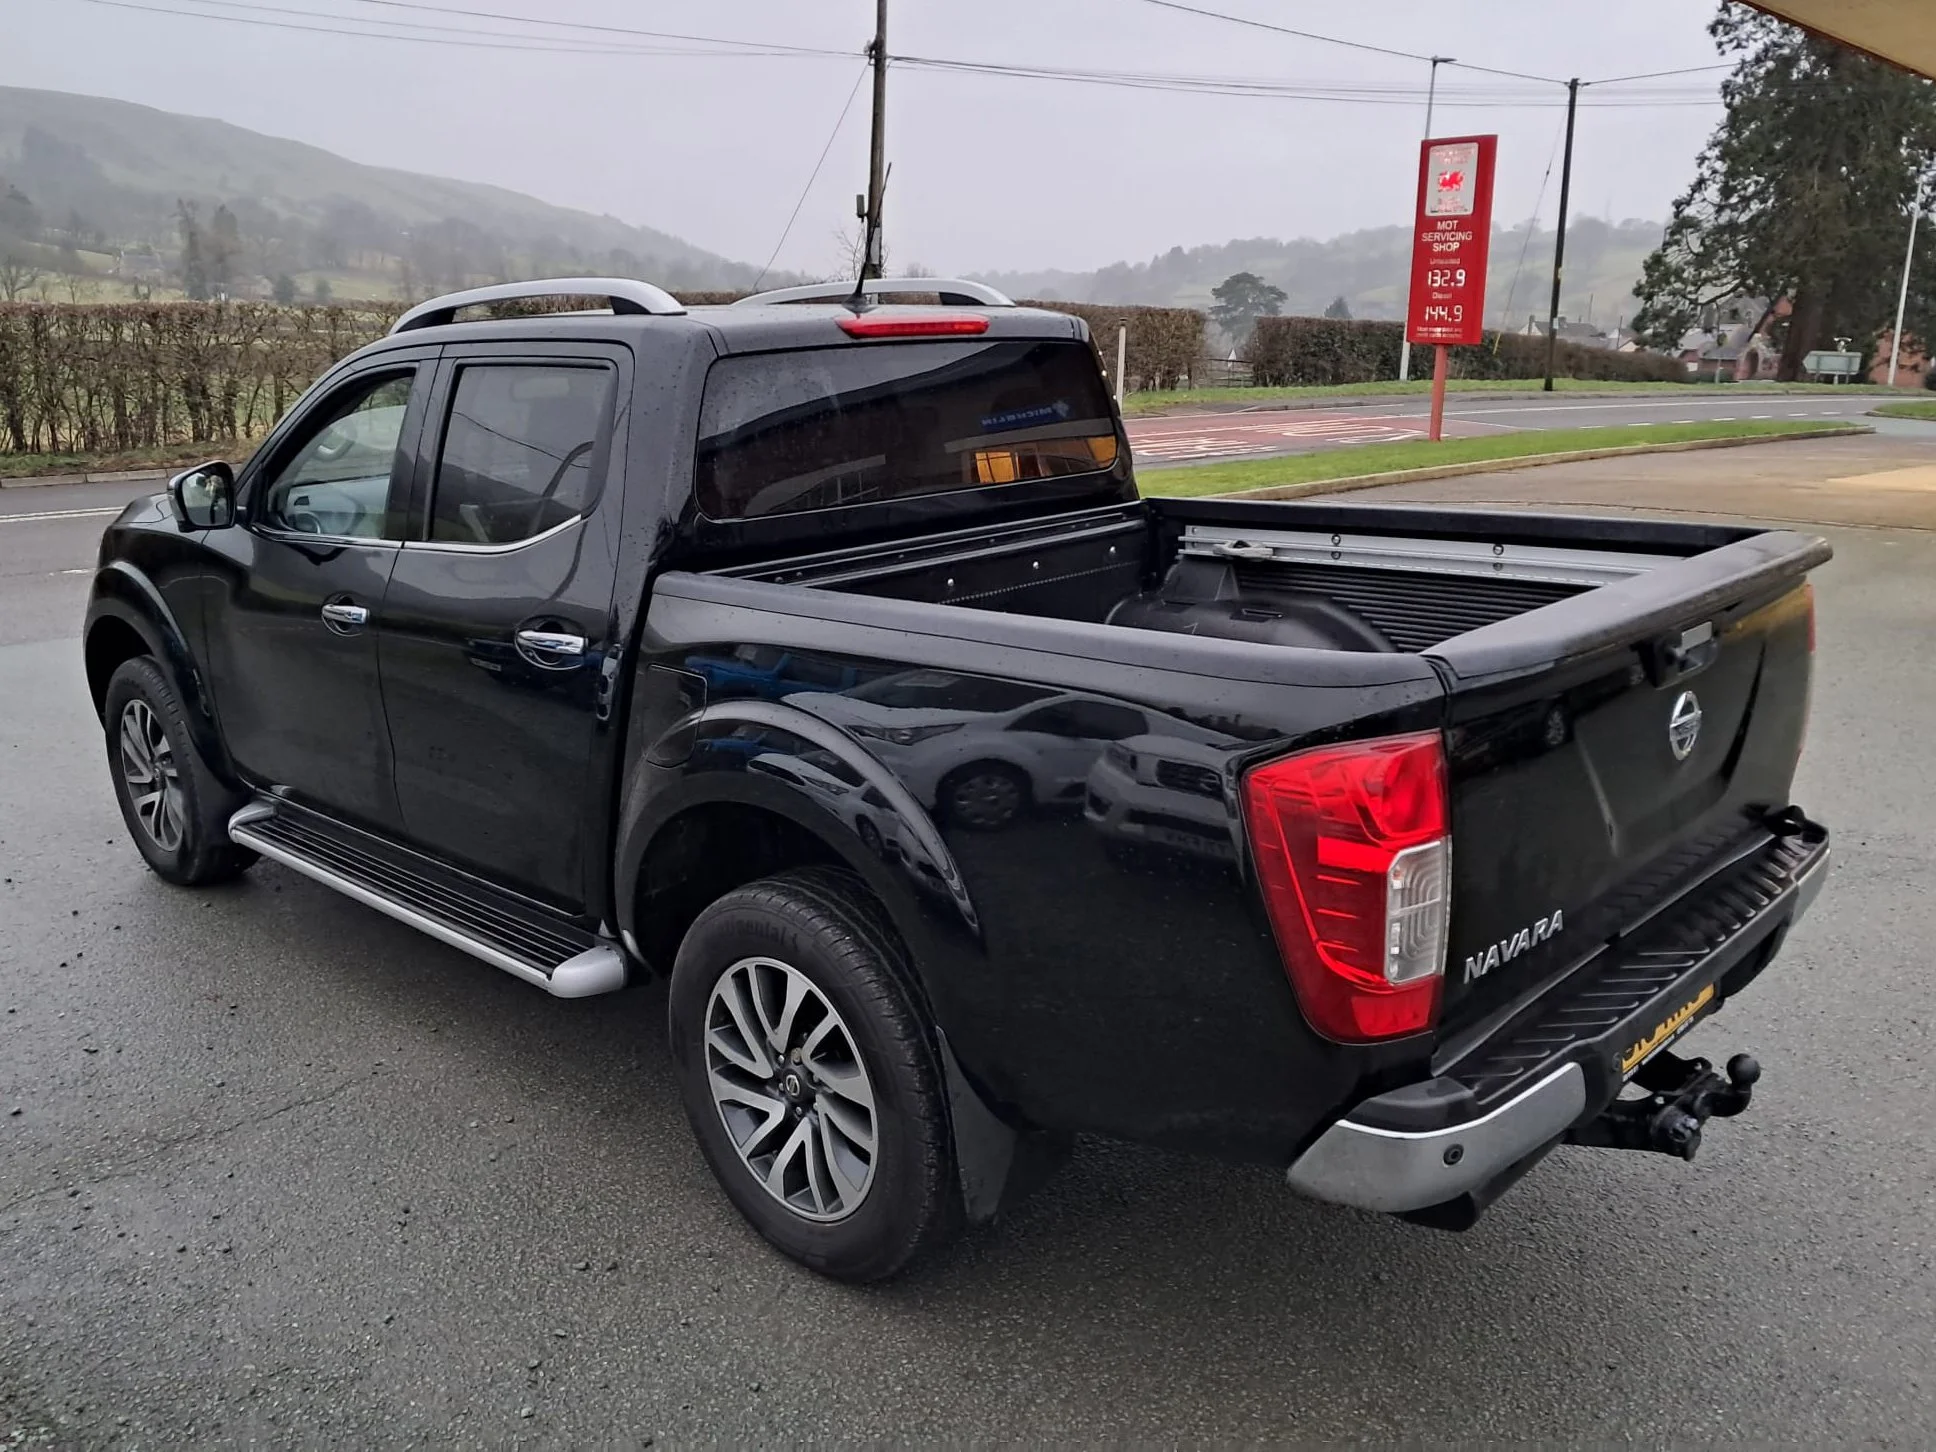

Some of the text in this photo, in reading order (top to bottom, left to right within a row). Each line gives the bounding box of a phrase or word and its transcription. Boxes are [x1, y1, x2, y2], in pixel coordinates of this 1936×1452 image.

[1437, 220, 1458, 230] MOT
[1421, 231, 1473, 241] SERVICING
[1432, 242, 1460, 252] SHOP
[1427, 269, 1466, 287] 132.9
[1425, 305, 1463, 322] 144.9
[1463, 909, 1563, 984] NAVARA
